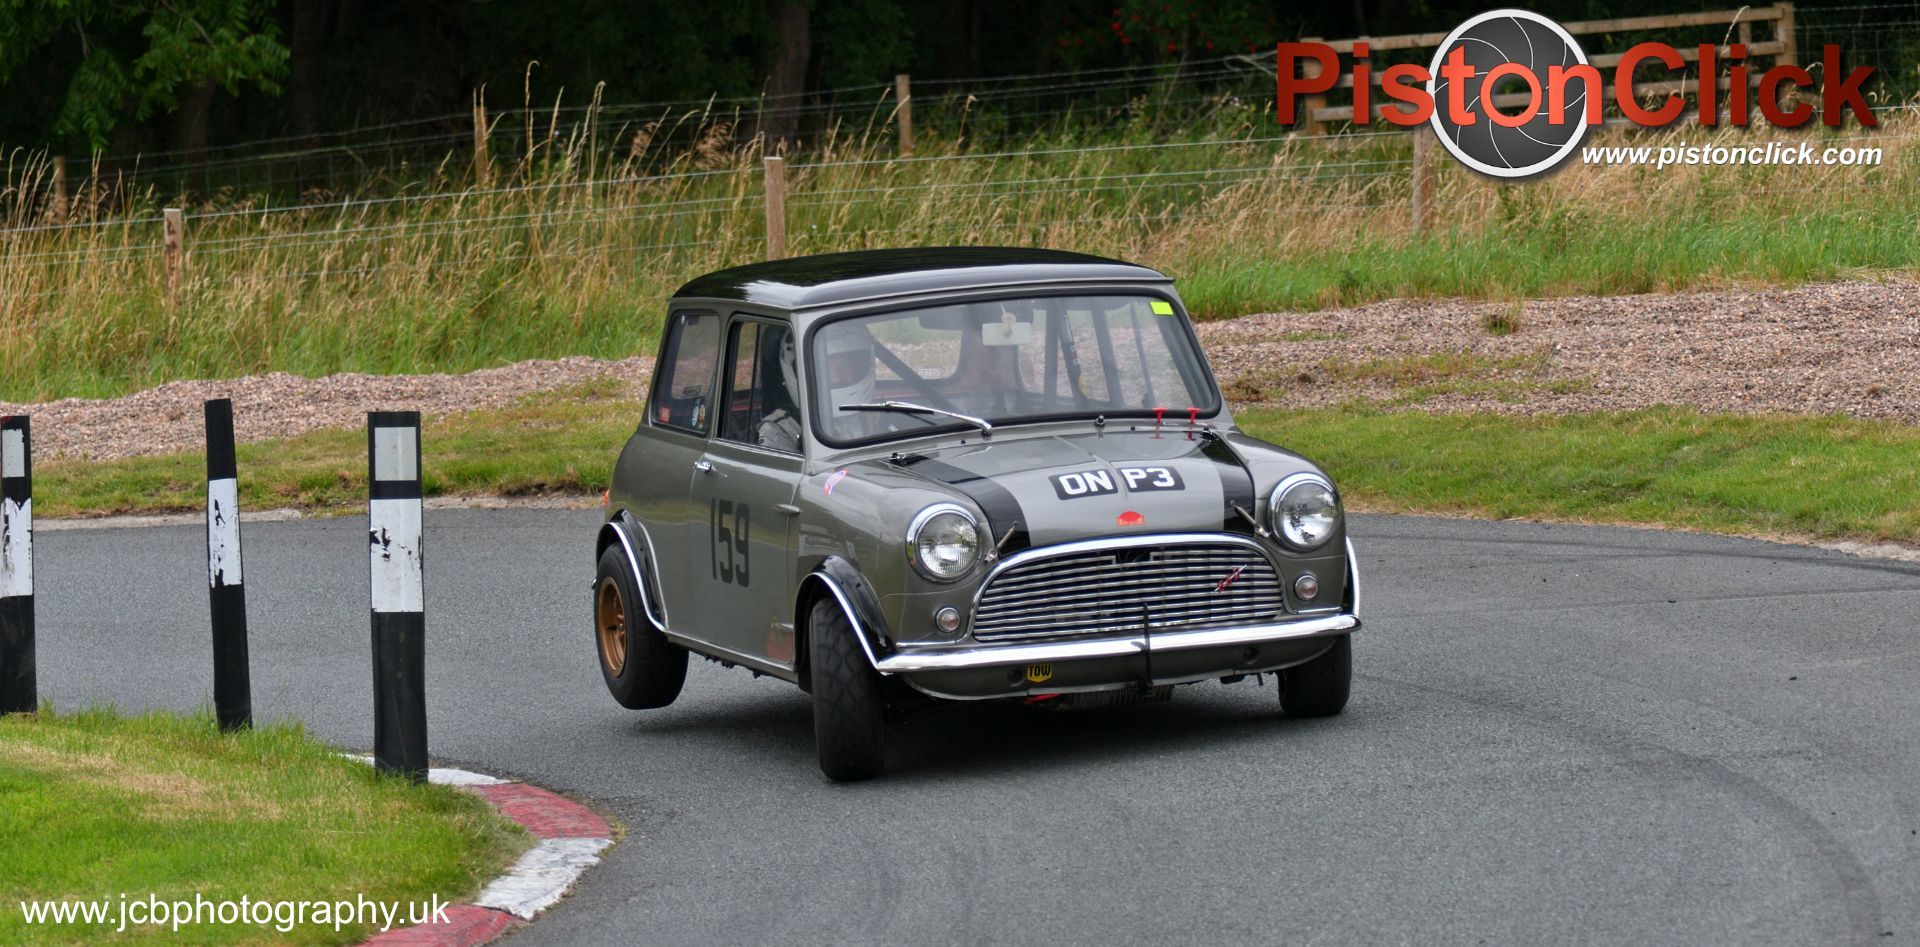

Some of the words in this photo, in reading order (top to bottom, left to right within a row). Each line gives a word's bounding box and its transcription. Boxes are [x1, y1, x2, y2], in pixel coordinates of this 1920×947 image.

[1058, 470, 1113, 495] ON
[1121, 467, 1175, 489] P3
[711, 499, 749, 588] 159
[1028, 664, 1051, 677] TOW
